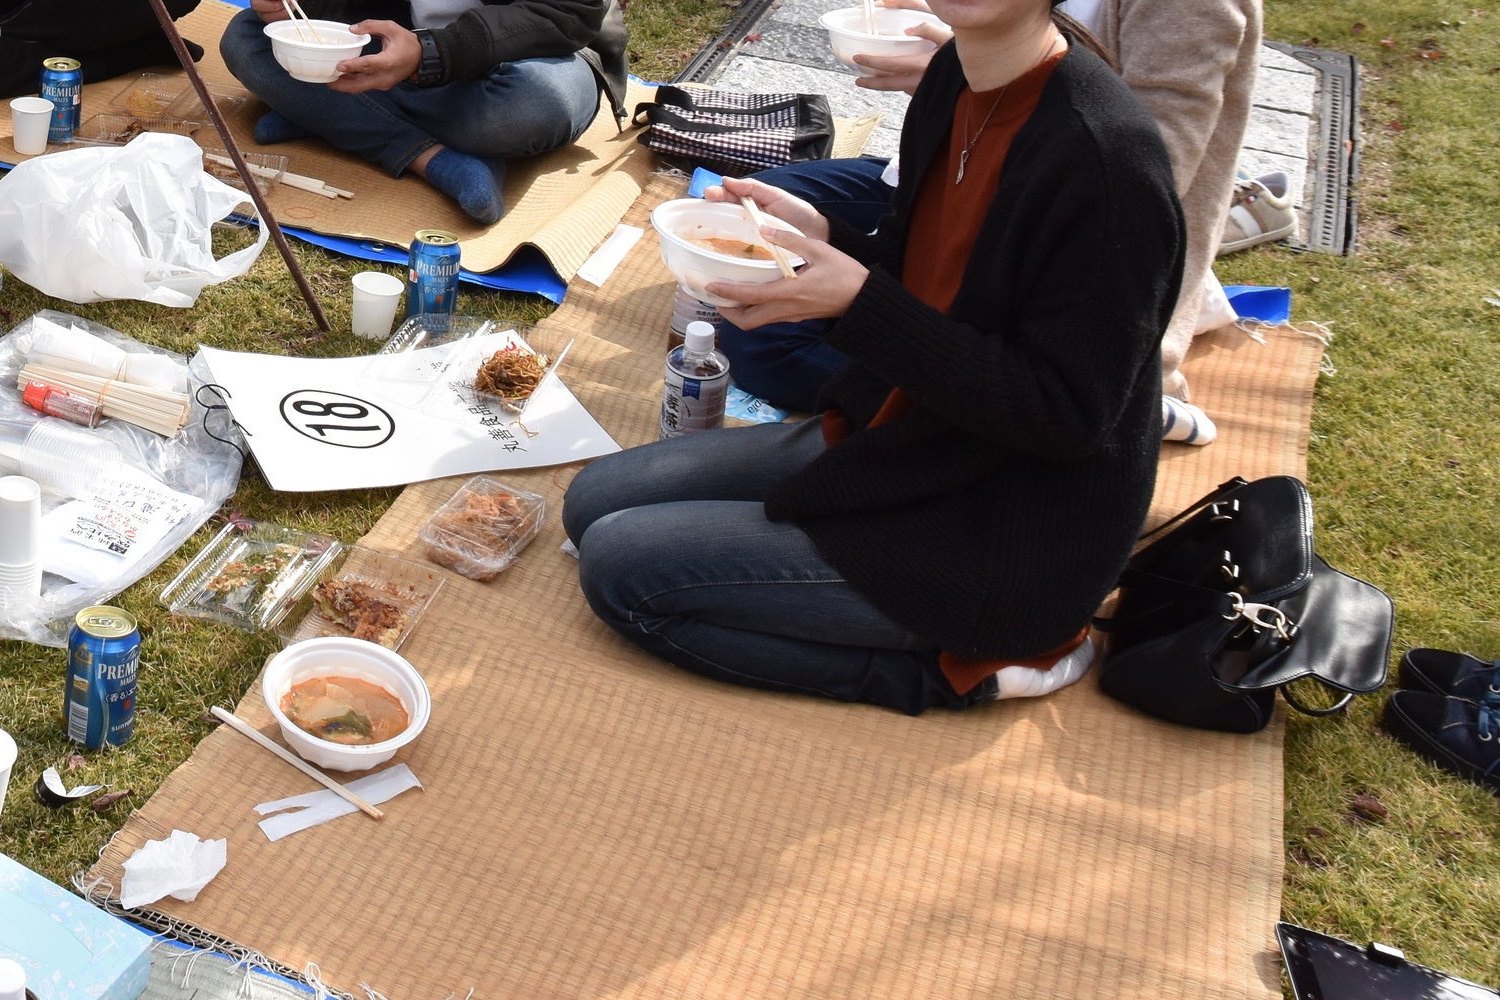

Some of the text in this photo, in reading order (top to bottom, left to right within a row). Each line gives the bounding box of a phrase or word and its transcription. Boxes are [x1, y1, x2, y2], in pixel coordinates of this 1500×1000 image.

[41, 83, 80, 97] PREMIUM
[416, 260, 460, 277] PREMIUM
[97, 656, 140, 681] PREMI
